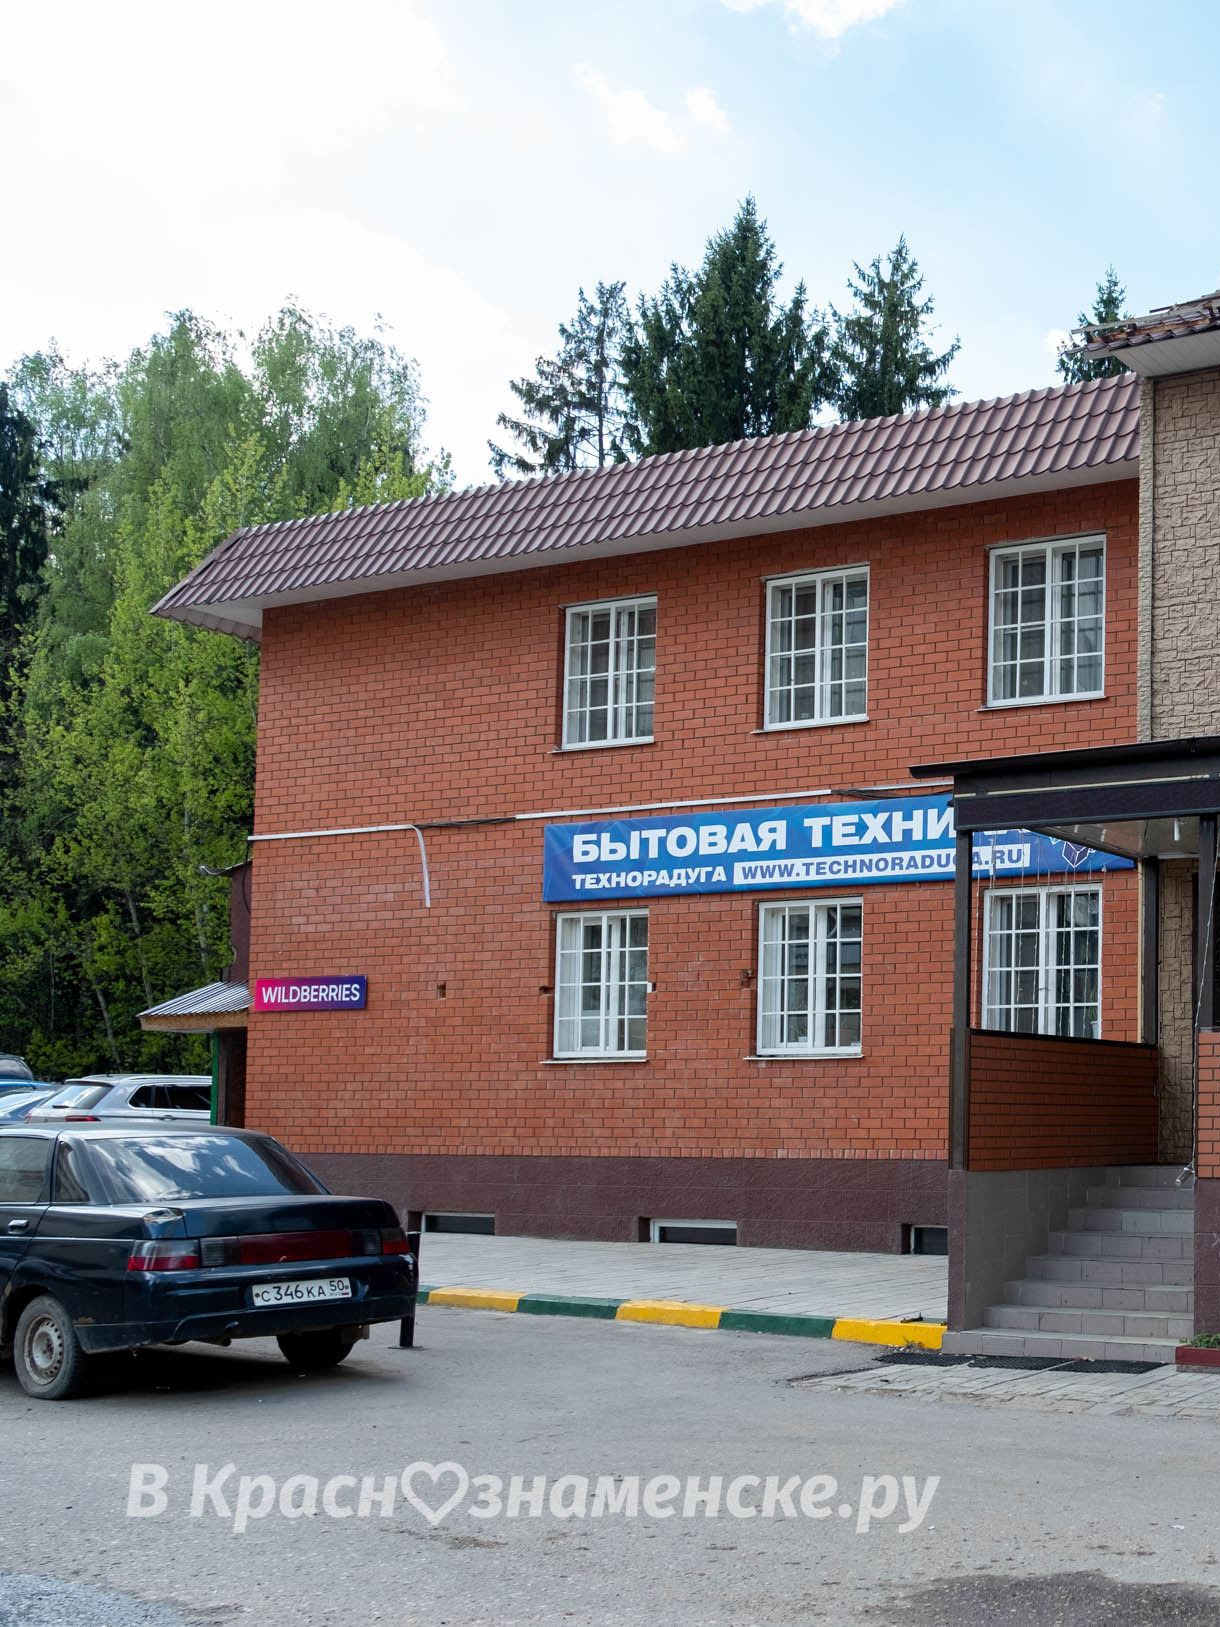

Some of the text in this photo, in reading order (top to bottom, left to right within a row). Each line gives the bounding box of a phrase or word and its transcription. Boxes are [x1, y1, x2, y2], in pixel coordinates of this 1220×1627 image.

[572, 807, 957, 863] БЫТОВАЯ ТЕХНИ
[572, 866, 727, 890] ТЕХНОРАДУГА
[261, 983, 361, 1004] WILDBERRIES
[328, 1279, 345, 1292] 50
